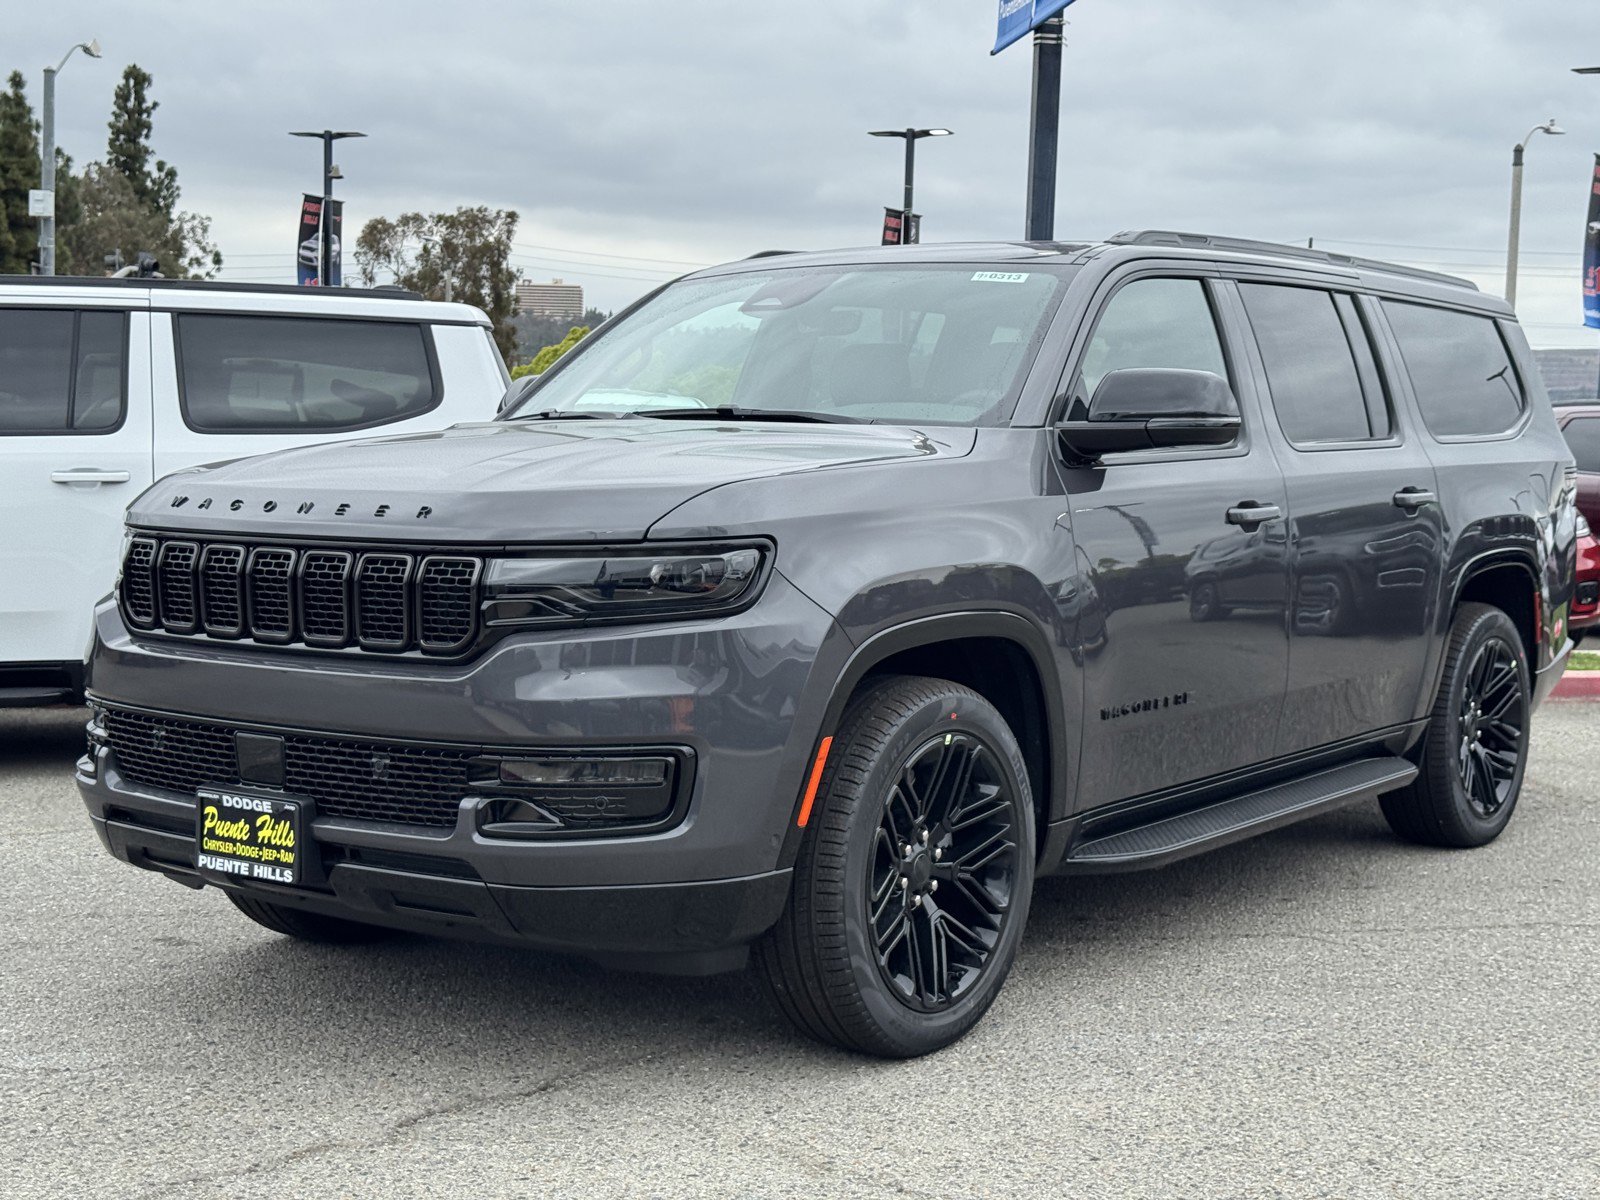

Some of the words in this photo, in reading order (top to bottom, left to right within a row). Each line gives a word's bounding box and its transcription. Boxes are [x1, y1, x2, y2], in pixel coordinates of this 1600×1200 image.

[170, 495, 433, 519] WAGONEER
[222, 795, 273, 813] DODGE
[203, 805, 250, 841] Puente
[255, 814, 296, 848] Hills
[203, 836, 233, 854] CHRYSLER
[236, 842, 259, 858] DODGE
[261, 846, 278, 861] JEEP
[198, 854, 250, 875] PUENTE
[253, 864, 293, 883] HILLS
